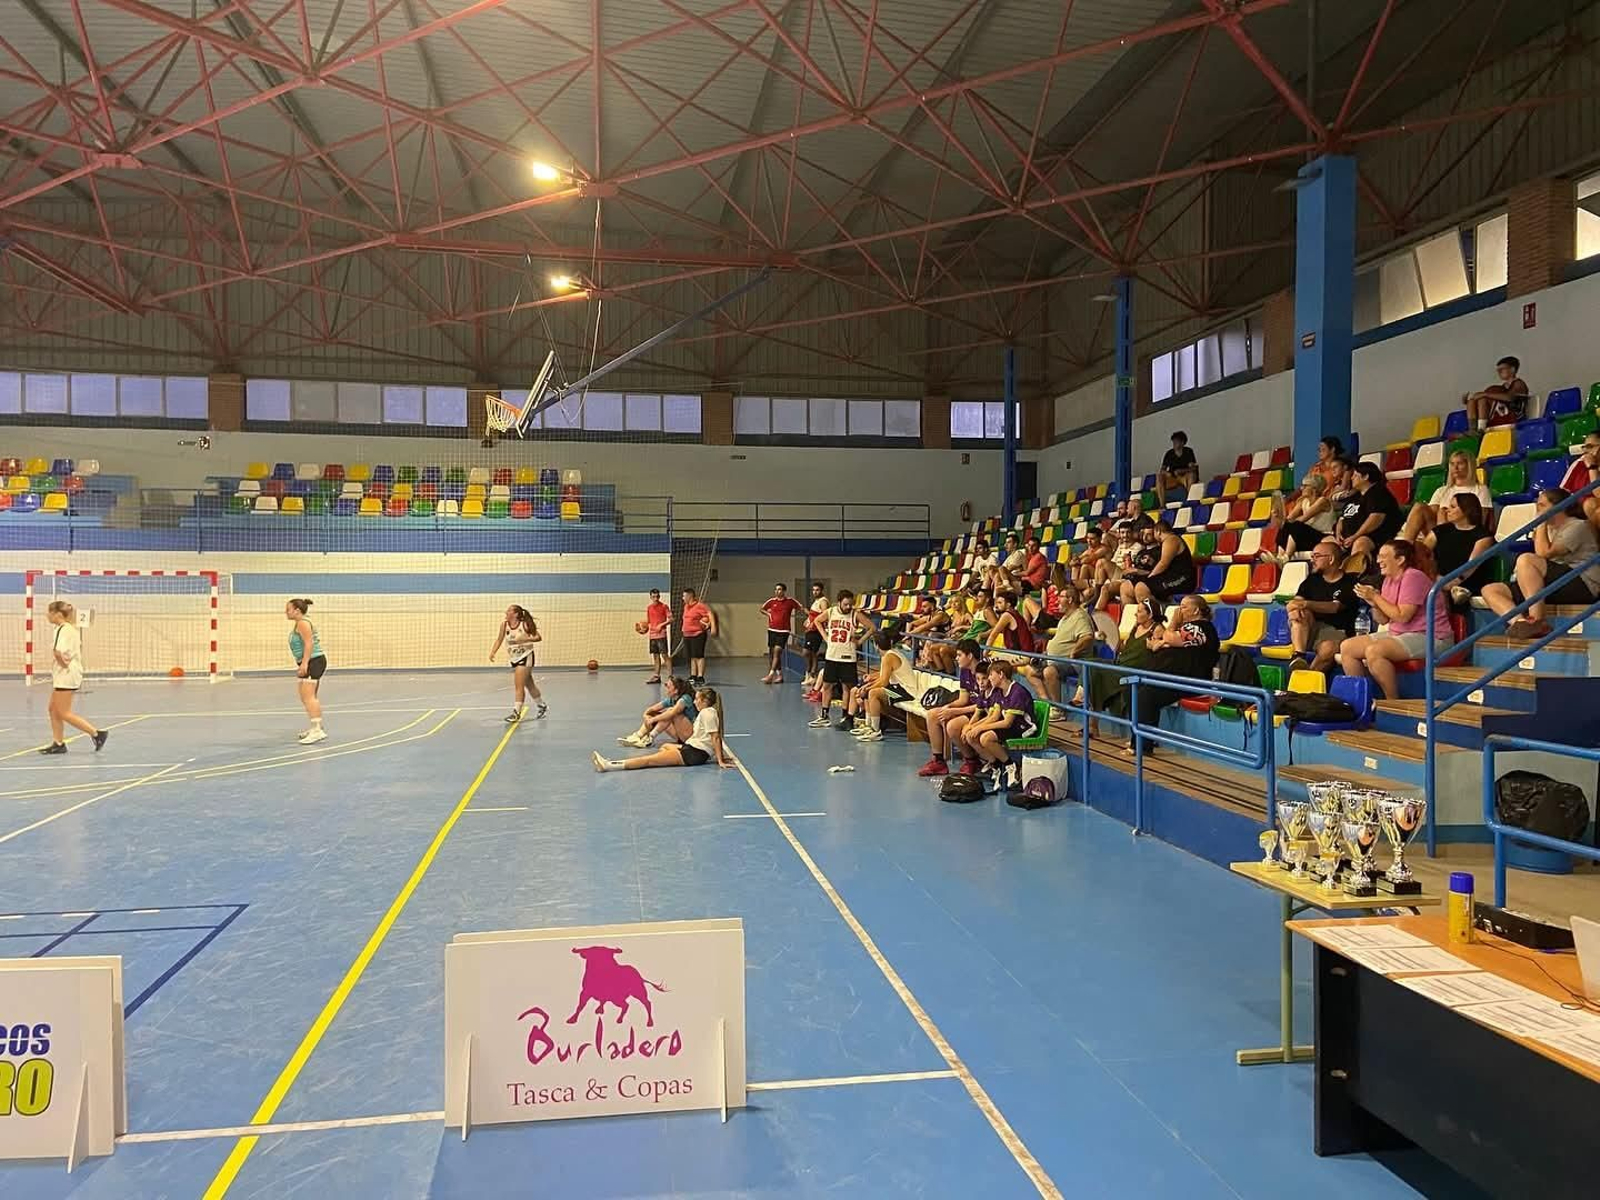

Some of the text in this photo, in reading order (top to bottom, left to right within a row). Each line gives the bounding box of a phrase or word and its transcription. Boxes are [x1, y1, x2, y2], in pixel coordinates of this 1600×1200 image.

[80, 613, 86, 622] 2
[831, 630, 848, 643] 23
[517, 1006, 682, 1065] Burladero
[507, 1075, 693, 1106] Tasca & Copas
